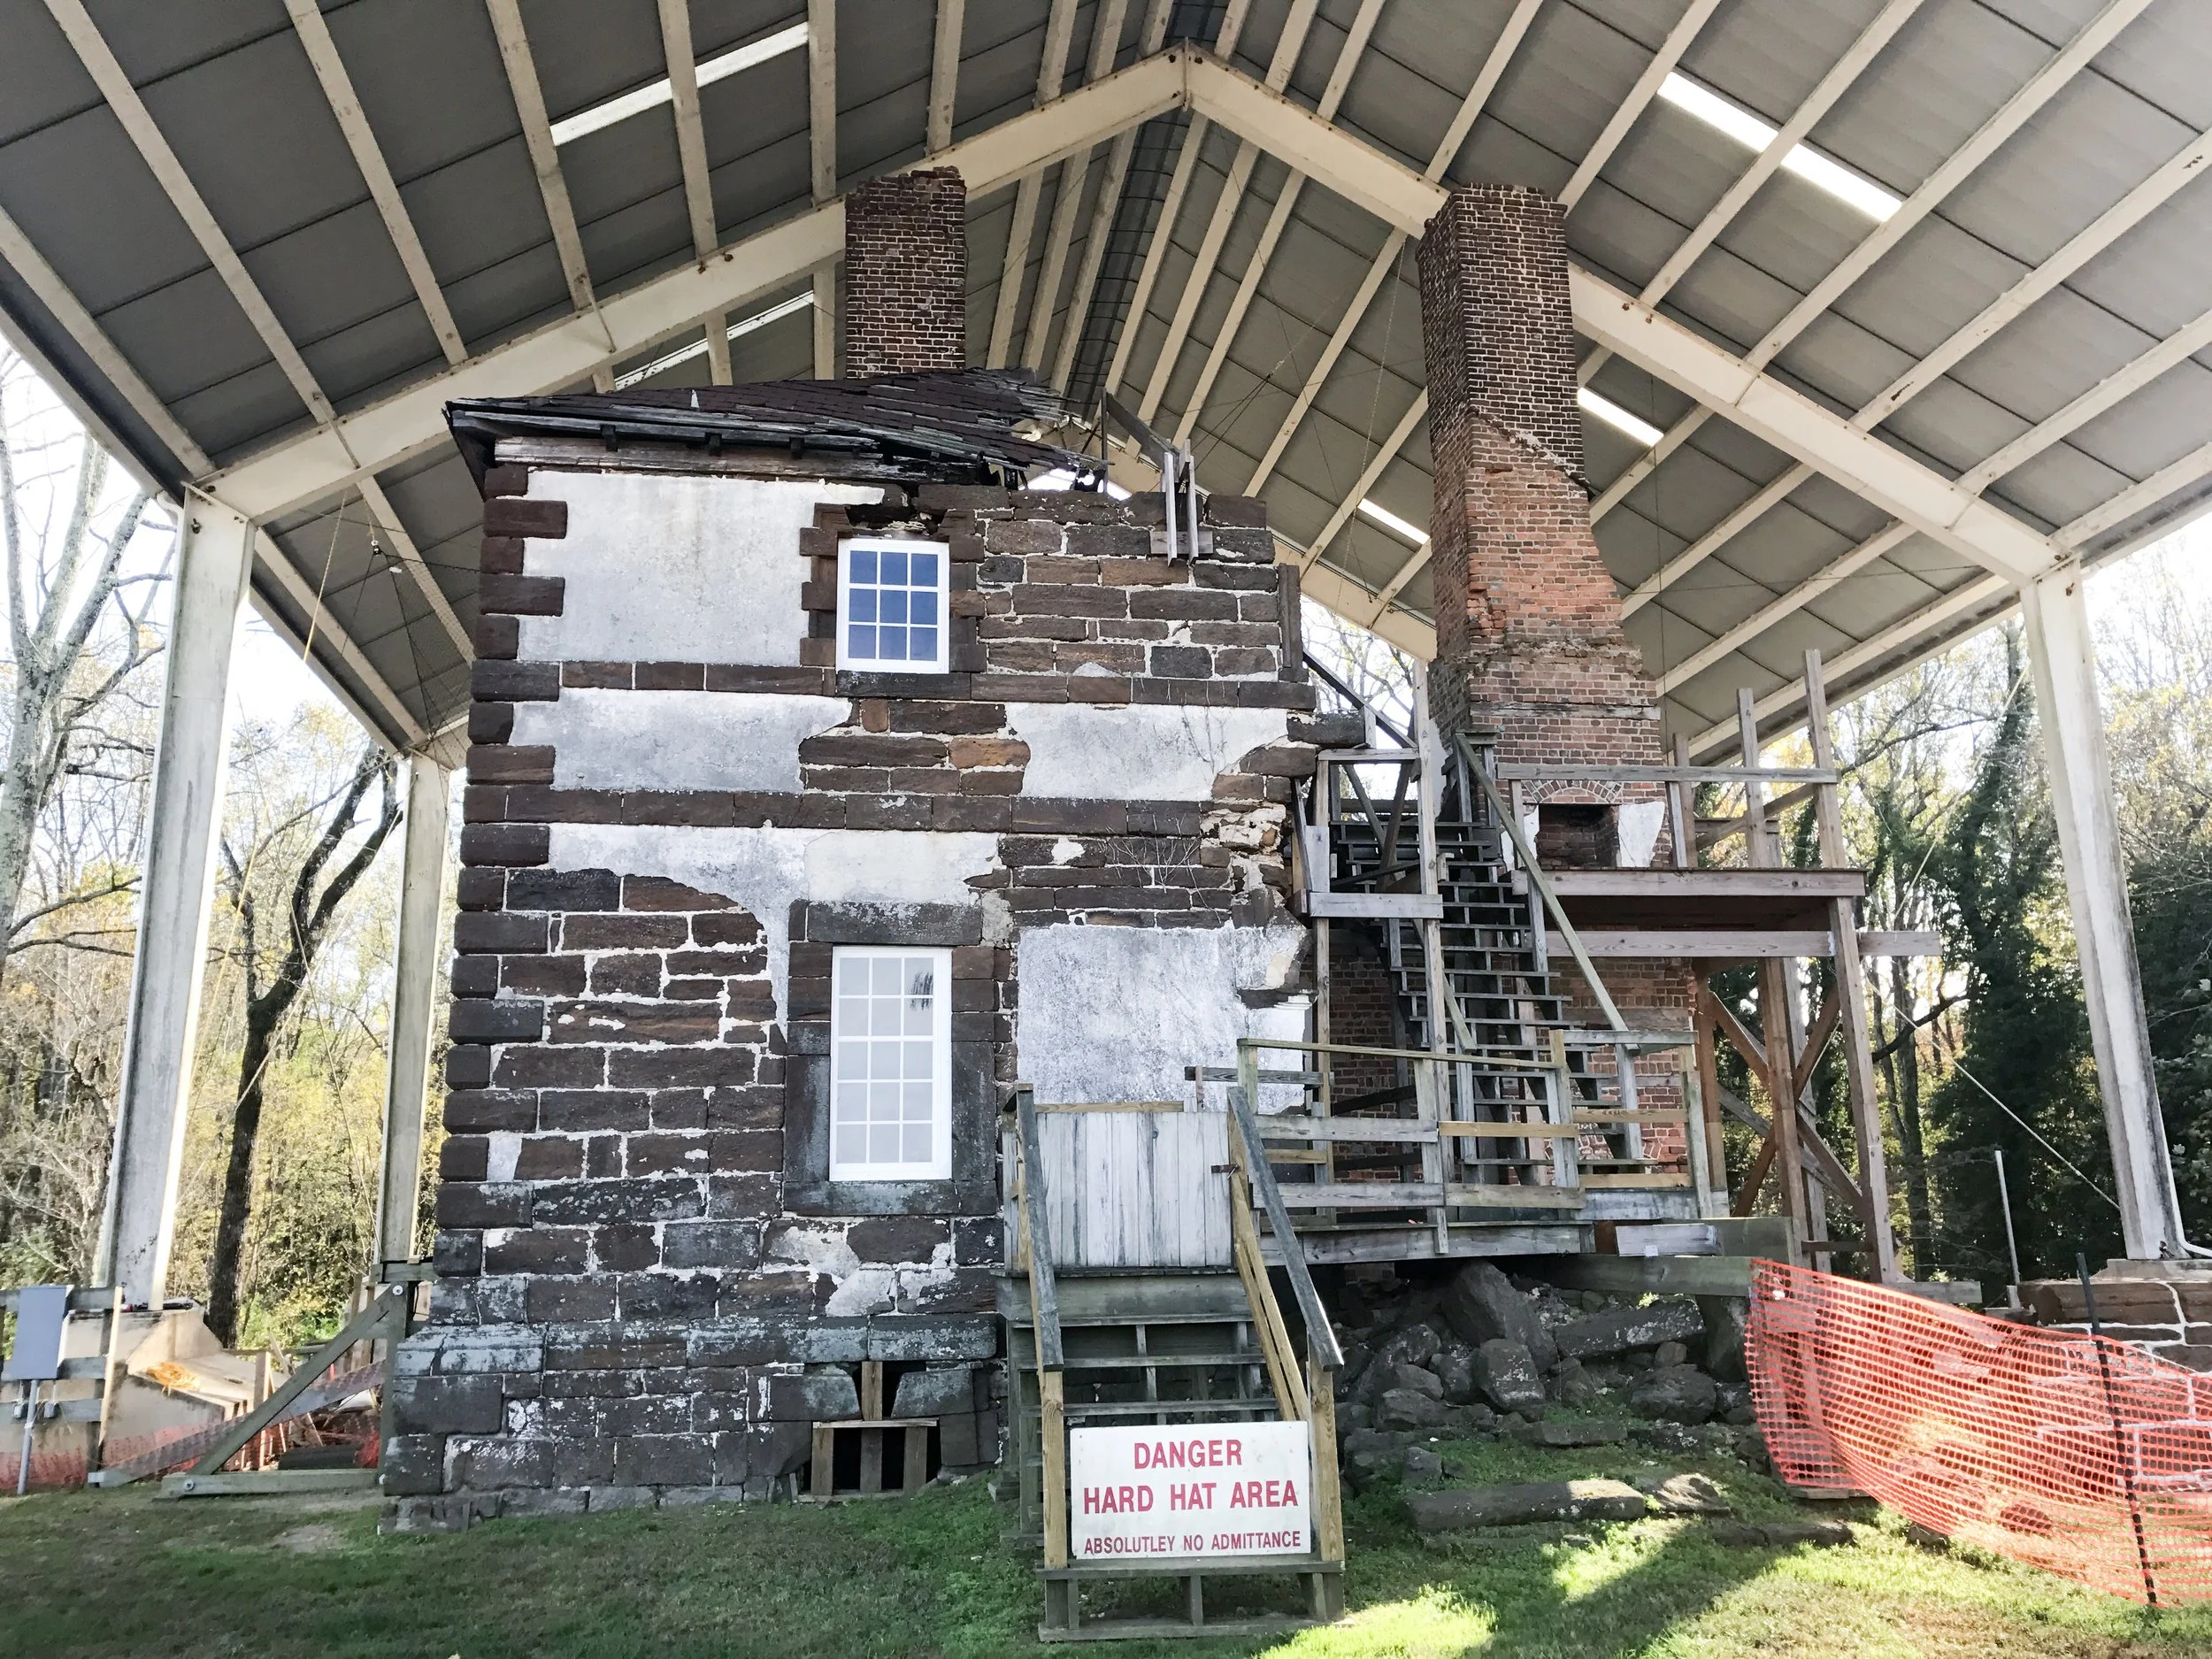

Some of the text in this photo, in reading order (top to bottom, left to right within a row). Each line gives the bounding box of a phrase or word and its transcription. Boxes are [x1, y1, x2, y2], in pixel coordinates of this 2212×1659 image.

[1134, 1440, 1242, 1469] DANGER
[1084, 1480, 1298, 1514] HARD HAT AREA
[1084, 1531, 1302, 1555] ABSOLUTLEY NO ADMITTANCE
